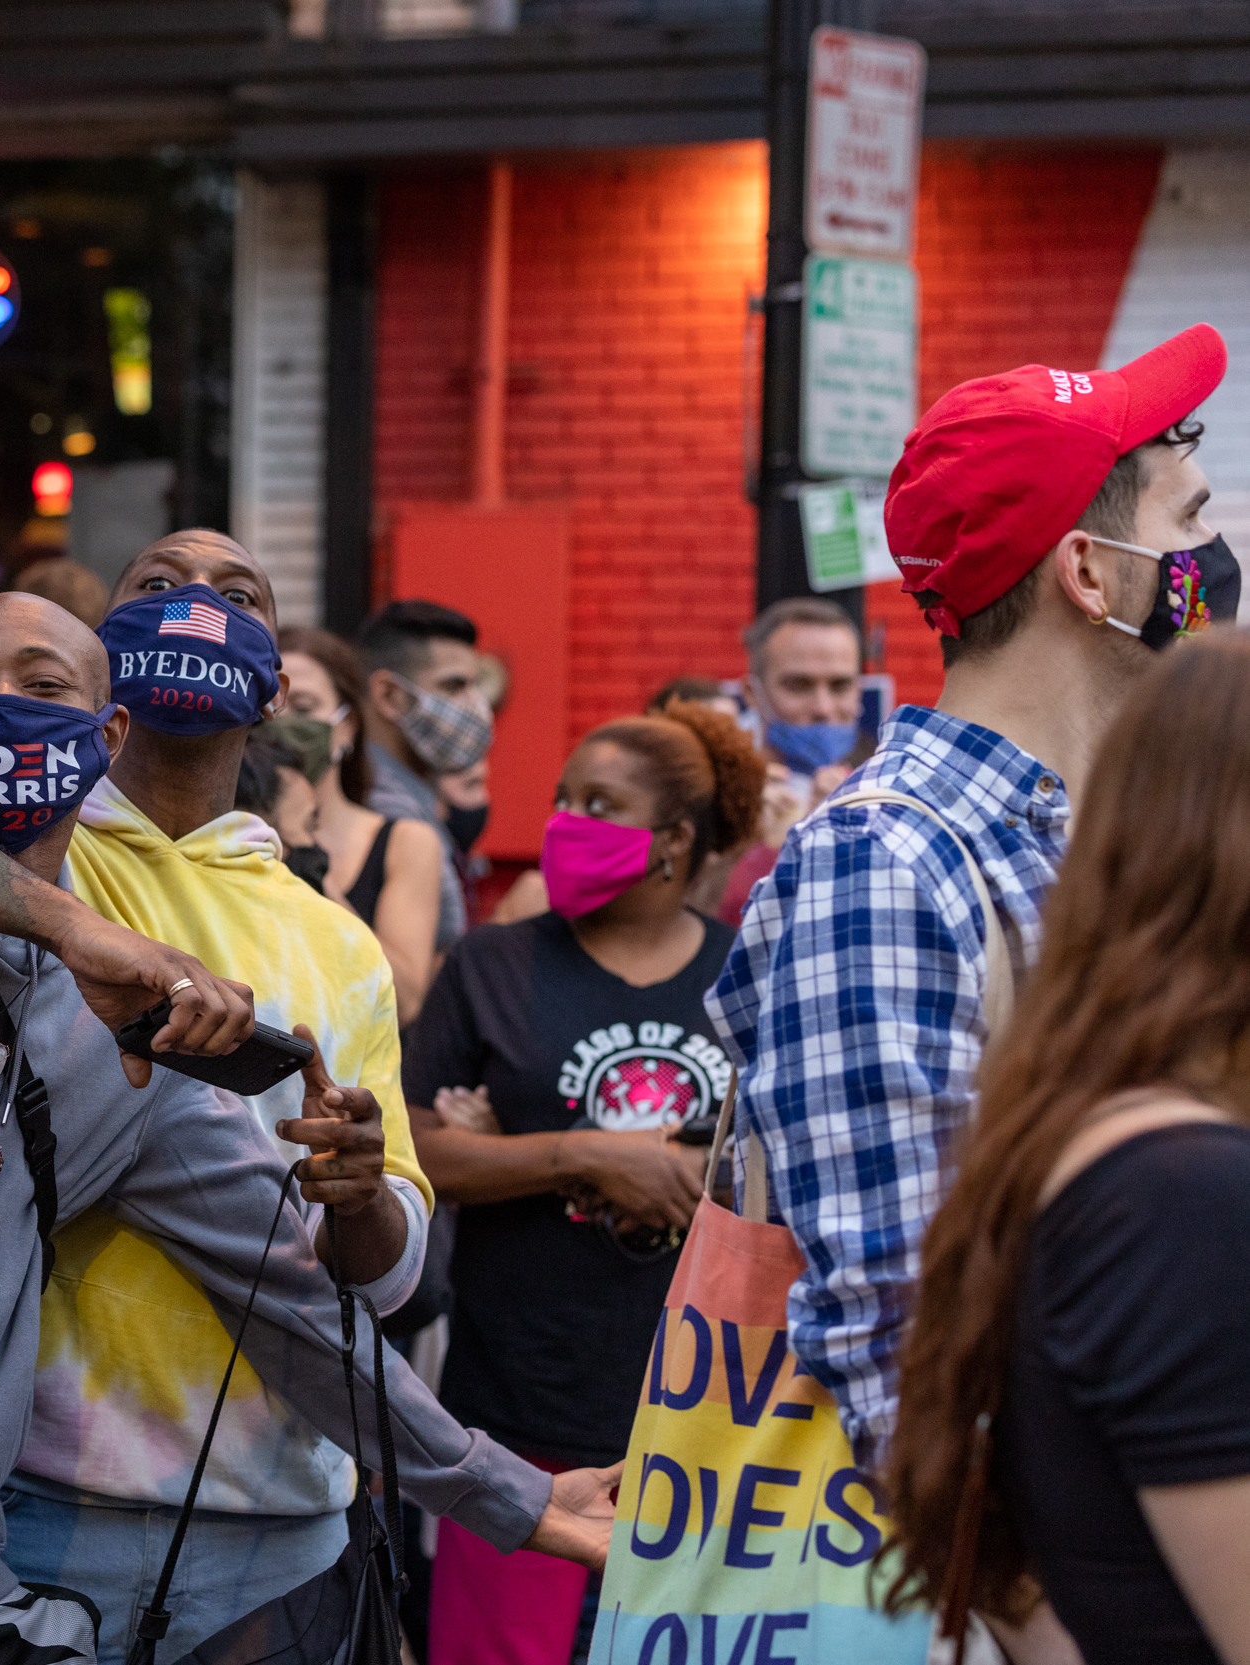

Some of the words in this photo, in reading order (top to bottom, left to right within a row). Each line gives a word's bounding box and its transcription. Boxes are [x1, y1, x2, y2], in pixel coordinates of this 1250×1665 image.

[1048, 369, 1072, 404] MAKE
[118, 650, 254, 697] BYEDON
[149, 686, 213, 712] 2020
[557, 1022, 635, 1099] CLASS
[638, 1020, 685, 1048] OF
[680, 1033, 735, 1101] 2020
